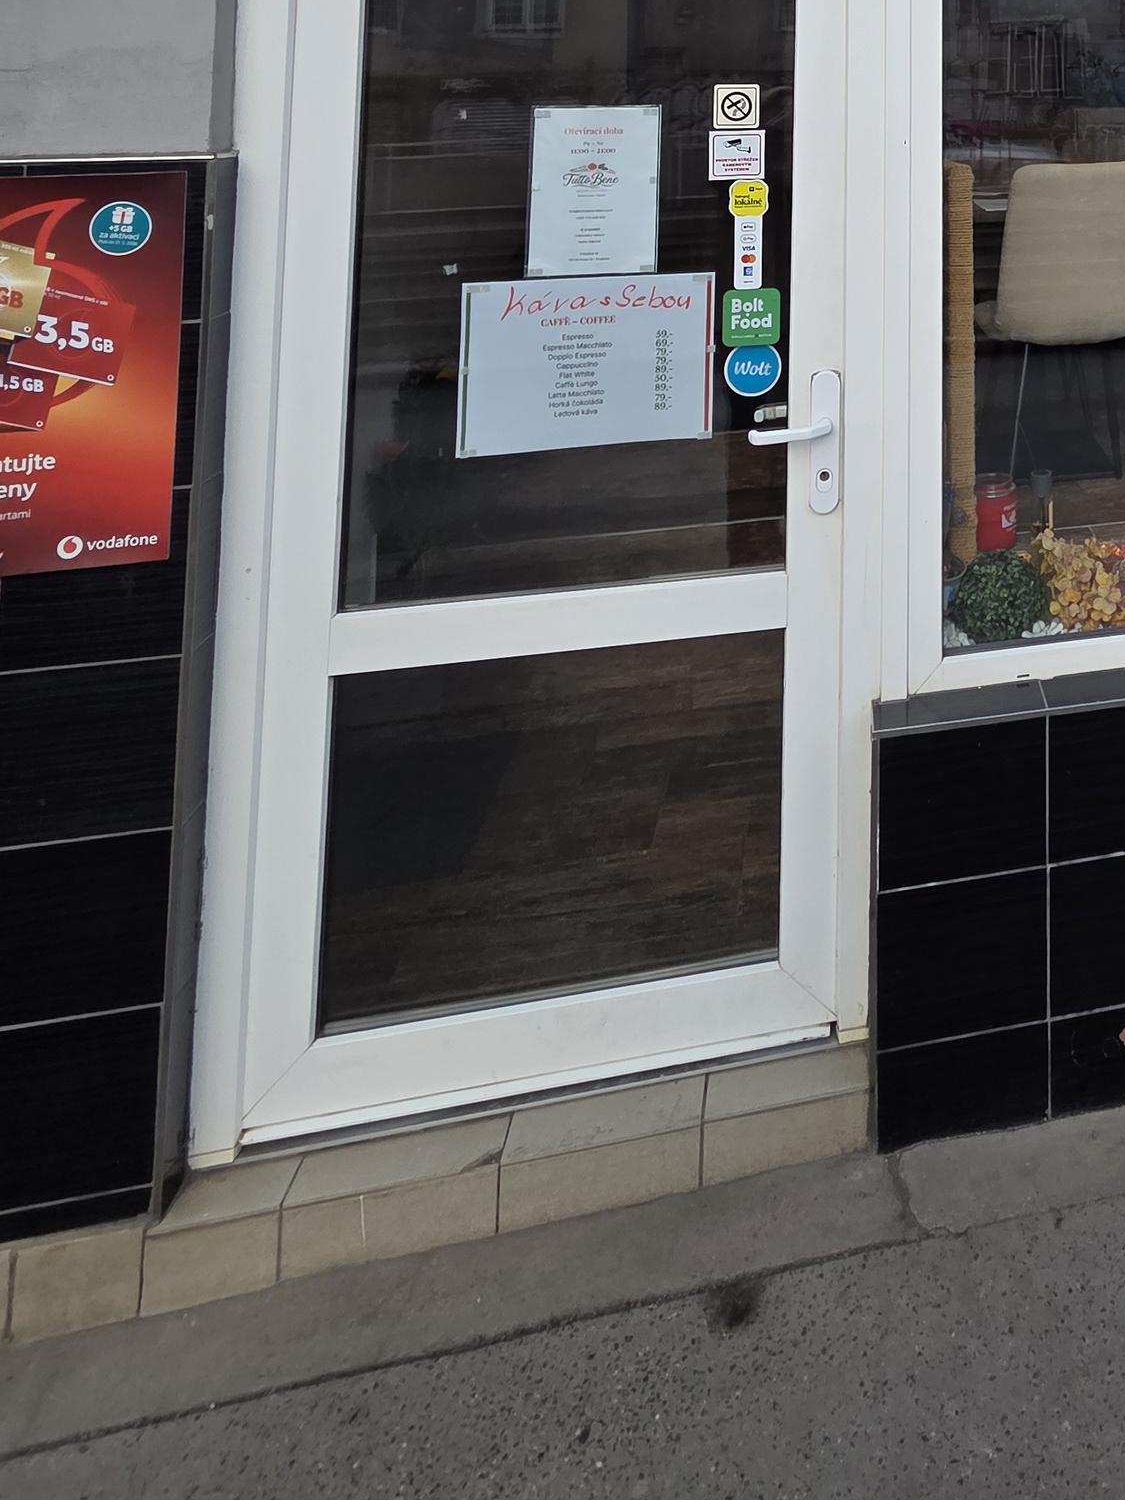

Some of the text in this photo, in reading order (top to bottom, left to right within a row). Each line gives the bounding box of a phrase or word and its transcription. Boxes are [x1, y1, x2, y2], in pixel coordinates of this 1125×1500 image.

[500, 286, 597, 322] Káva
[616, 283, 691, 310] Sebou
[731, 298, 764, 313] Bolt
[579, 315, 616, 326] COFFEE
[731, 313, 773, 330] Food
[35, 314, 114, 353] 3,5 GB
[562, 333, 594, 341] Espresso
[543, 341, 613, 352] Espresso Macchiato
[575, 352, 607, 360] Espresso
[556, 361, 599, 370] Cappuccino
[734, 361, 772, 376] Wolt
[574, 370, 595, 378] White
[22, 377, 44, 393] GB
[576, 380, 599, 388] Lungo
[568, 389, 605, 397] Macchiato
[549, 401, 570, 409] Horká
[554, 408, 598, 418] Ledová káva
[87, 534, 158, 551] vodafone
